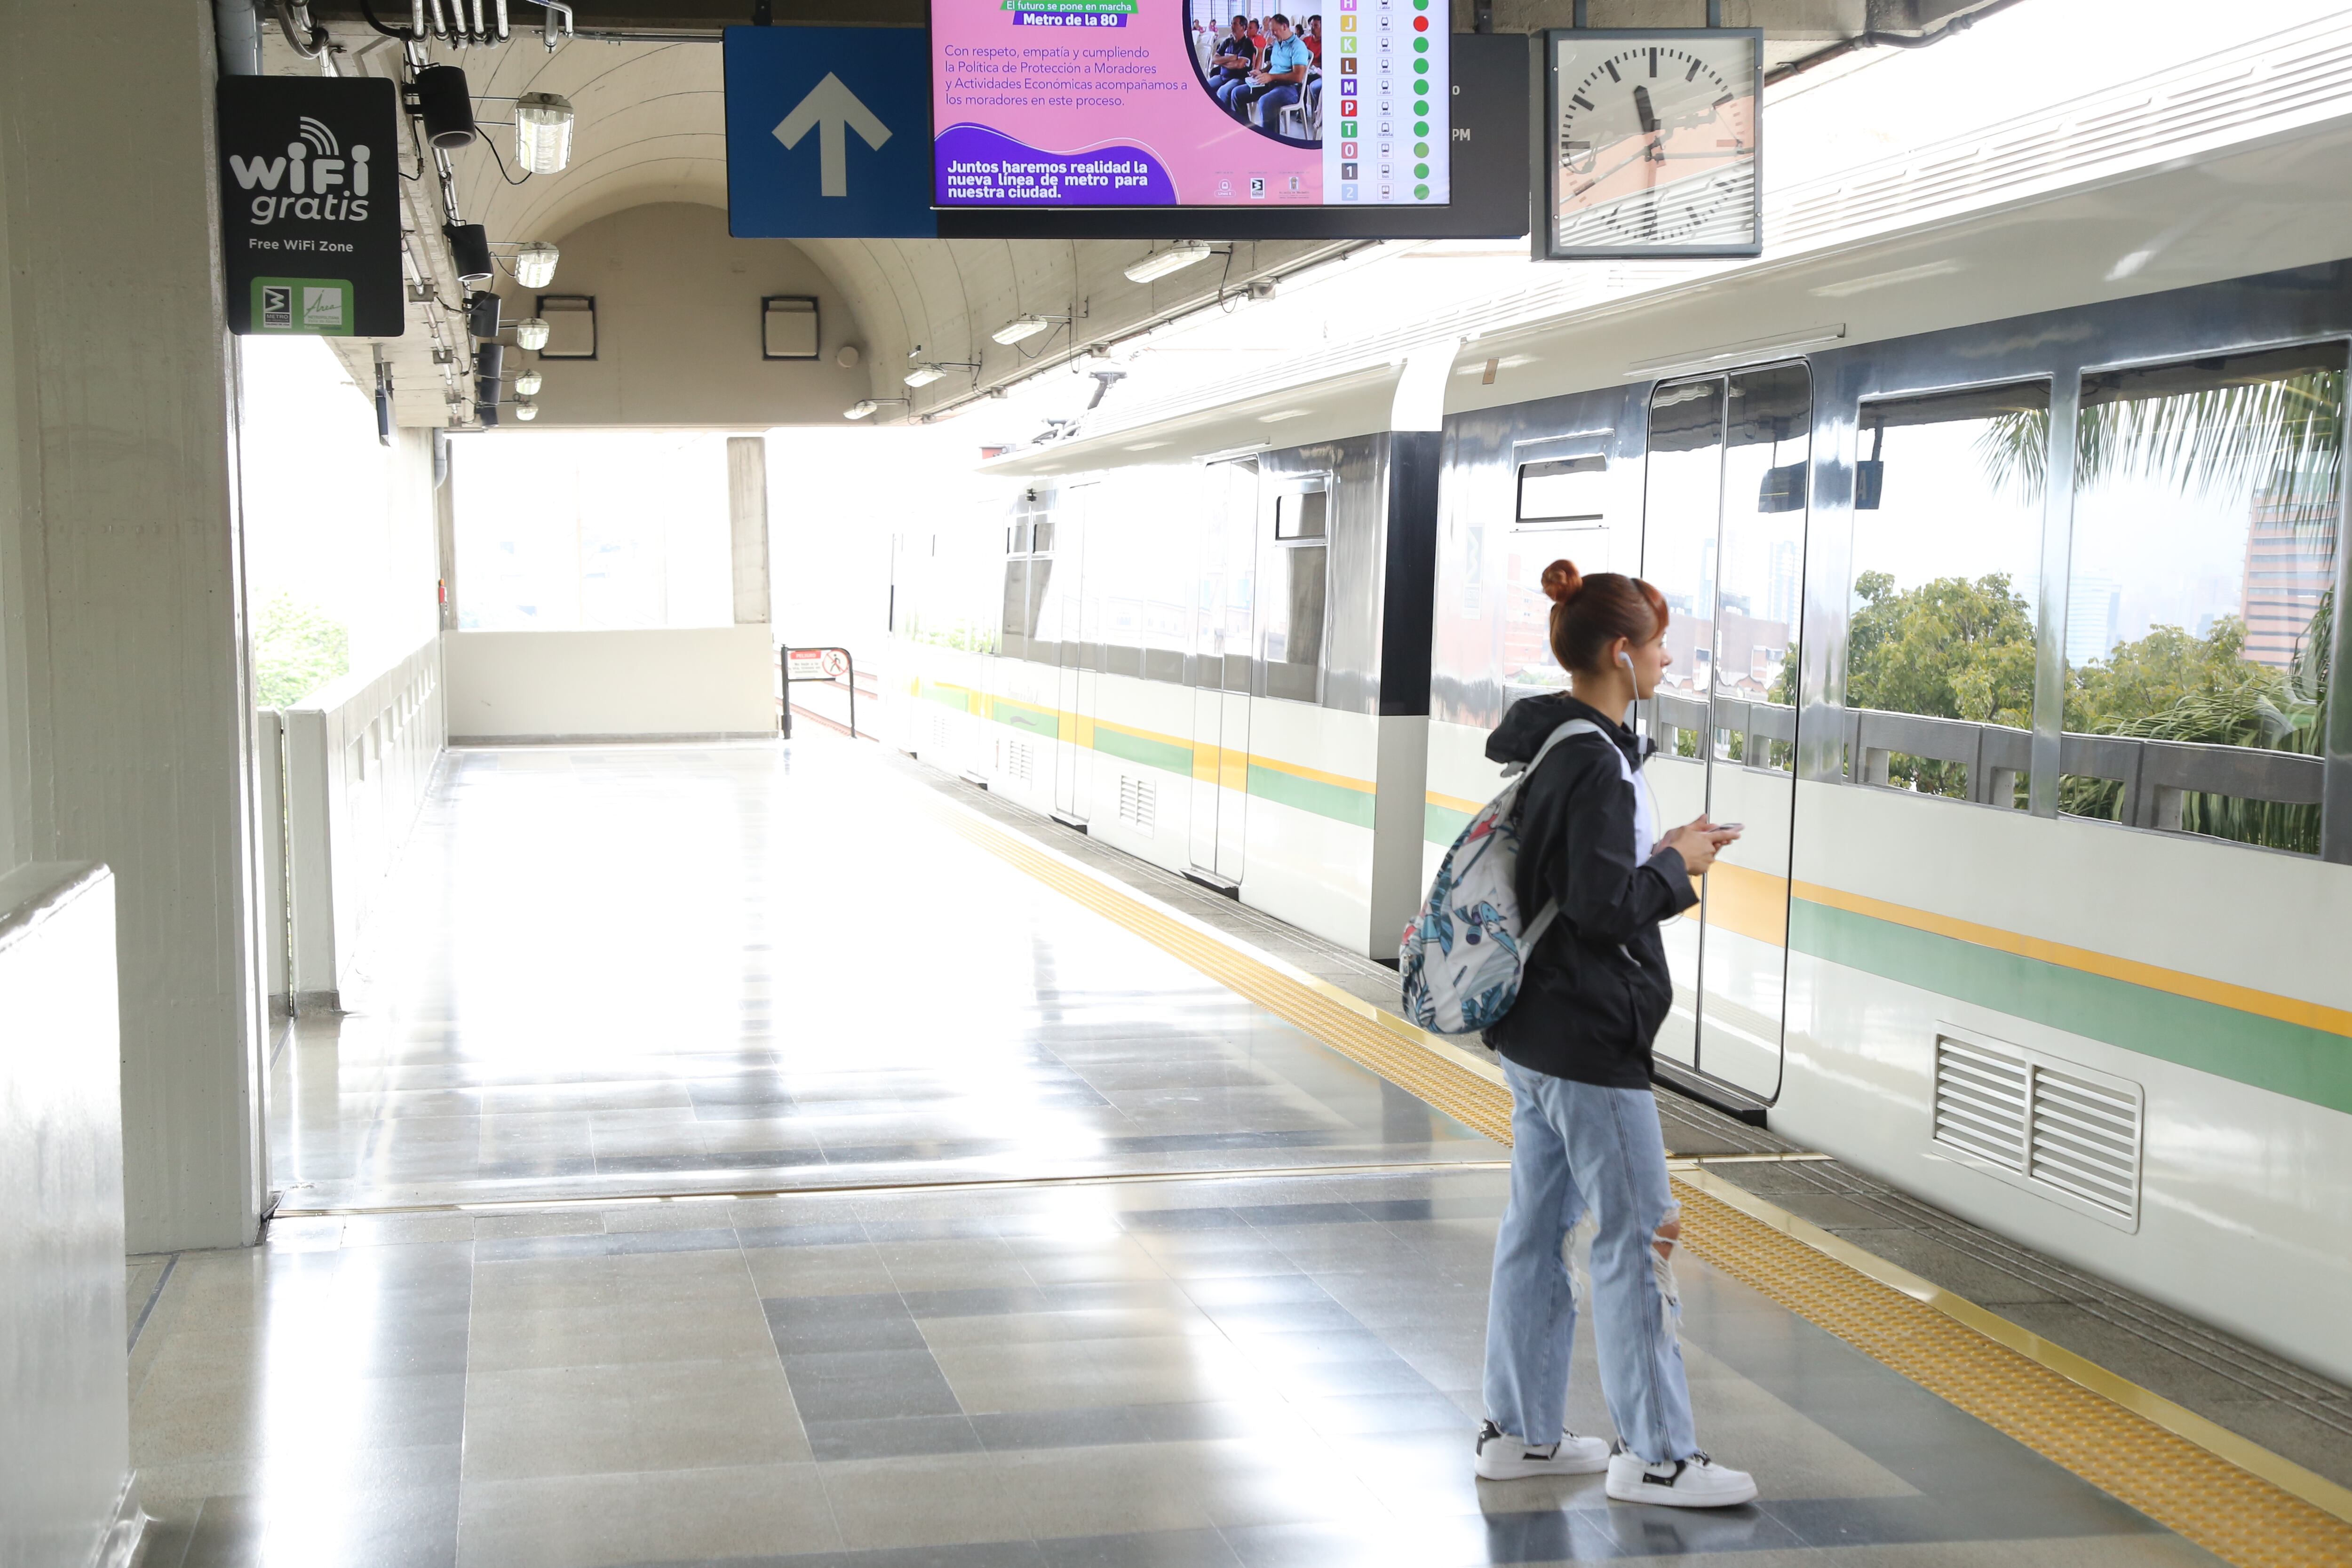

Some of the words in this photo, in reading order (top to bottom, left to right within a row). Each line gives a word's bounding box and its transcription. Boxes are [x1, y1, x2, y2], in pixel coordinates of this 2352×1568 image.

[1007, 1, 1015, 9] El
[1017, 1, 1044, 10] futuro
[1099, 1, 1131, 10] marcha
[1023, 13, 1063, 25] Metro
[1065, 14, 1081, 25] de
[1085, 14, 1097, 26] la
[1100, 14, 1118, 26] 80
[1345, 17, 1353, 30] J
[1344, 39, 1353, 51] K
[945, 45, 969, 56] Con
[972, 47, 1019, 60] respeto,
[1023, 46, 1069, 61] empatía
[1073, 49, 1079, 60] y
[1082, 46, 1149, 61] cumpliendo
[945, 61, 954, 72] la
[958, 61, 999, 72] Política
[1002, 61, 1017, 72] de
[1020, 62, 1081, 73] Protección
[1094, 62, 1157, 74] Moradores
[1345, 60, 1353, 72] L
[945, 80, 952, 91] y
[954, 77, 1021, 89] Actividades
[1025, 78, 1092, 89] Económicas
[1095, 79, 1178, 94] acompañamos
[1344, 81, 1354, 93] M
[946, 93, 962, 104] los
[965, 93, 1028, 105] moradores
[1049, 96, 1073, 105] este
[1076, 97, 1125, 110] proceso.
[1345, 102, 1354, 115] P
[1345, 123, 1354, 135] T
[1452, 128, 1470, 141] PM
[947, 160, 999, 174] Juntos
[1002, 160, 1067, 174] haremos
[1070, 160, 1130, 174] realidad
[1134, 161, 1148, 174] la
[1346, 166, 1352, 177] 1
[947, 175, 992, 185] nueva
[998, 172, 1034, 186] línea
[1040, 174, 1058, 186] de
[1065, 175, 1109, 186] metro
[1115, 175, 1148, 188] para
[948, 187, 1005, 198] nuestra
[1008, 186, 1061, 198] ciudad.
[1346, 187, 1354, 198] 2
[250, 190, 369, 225] gratis
[249, 239, 279, 249] Free
[283, 239, 315, 250] WiFi
[319, 241, 353, 252] Zone
